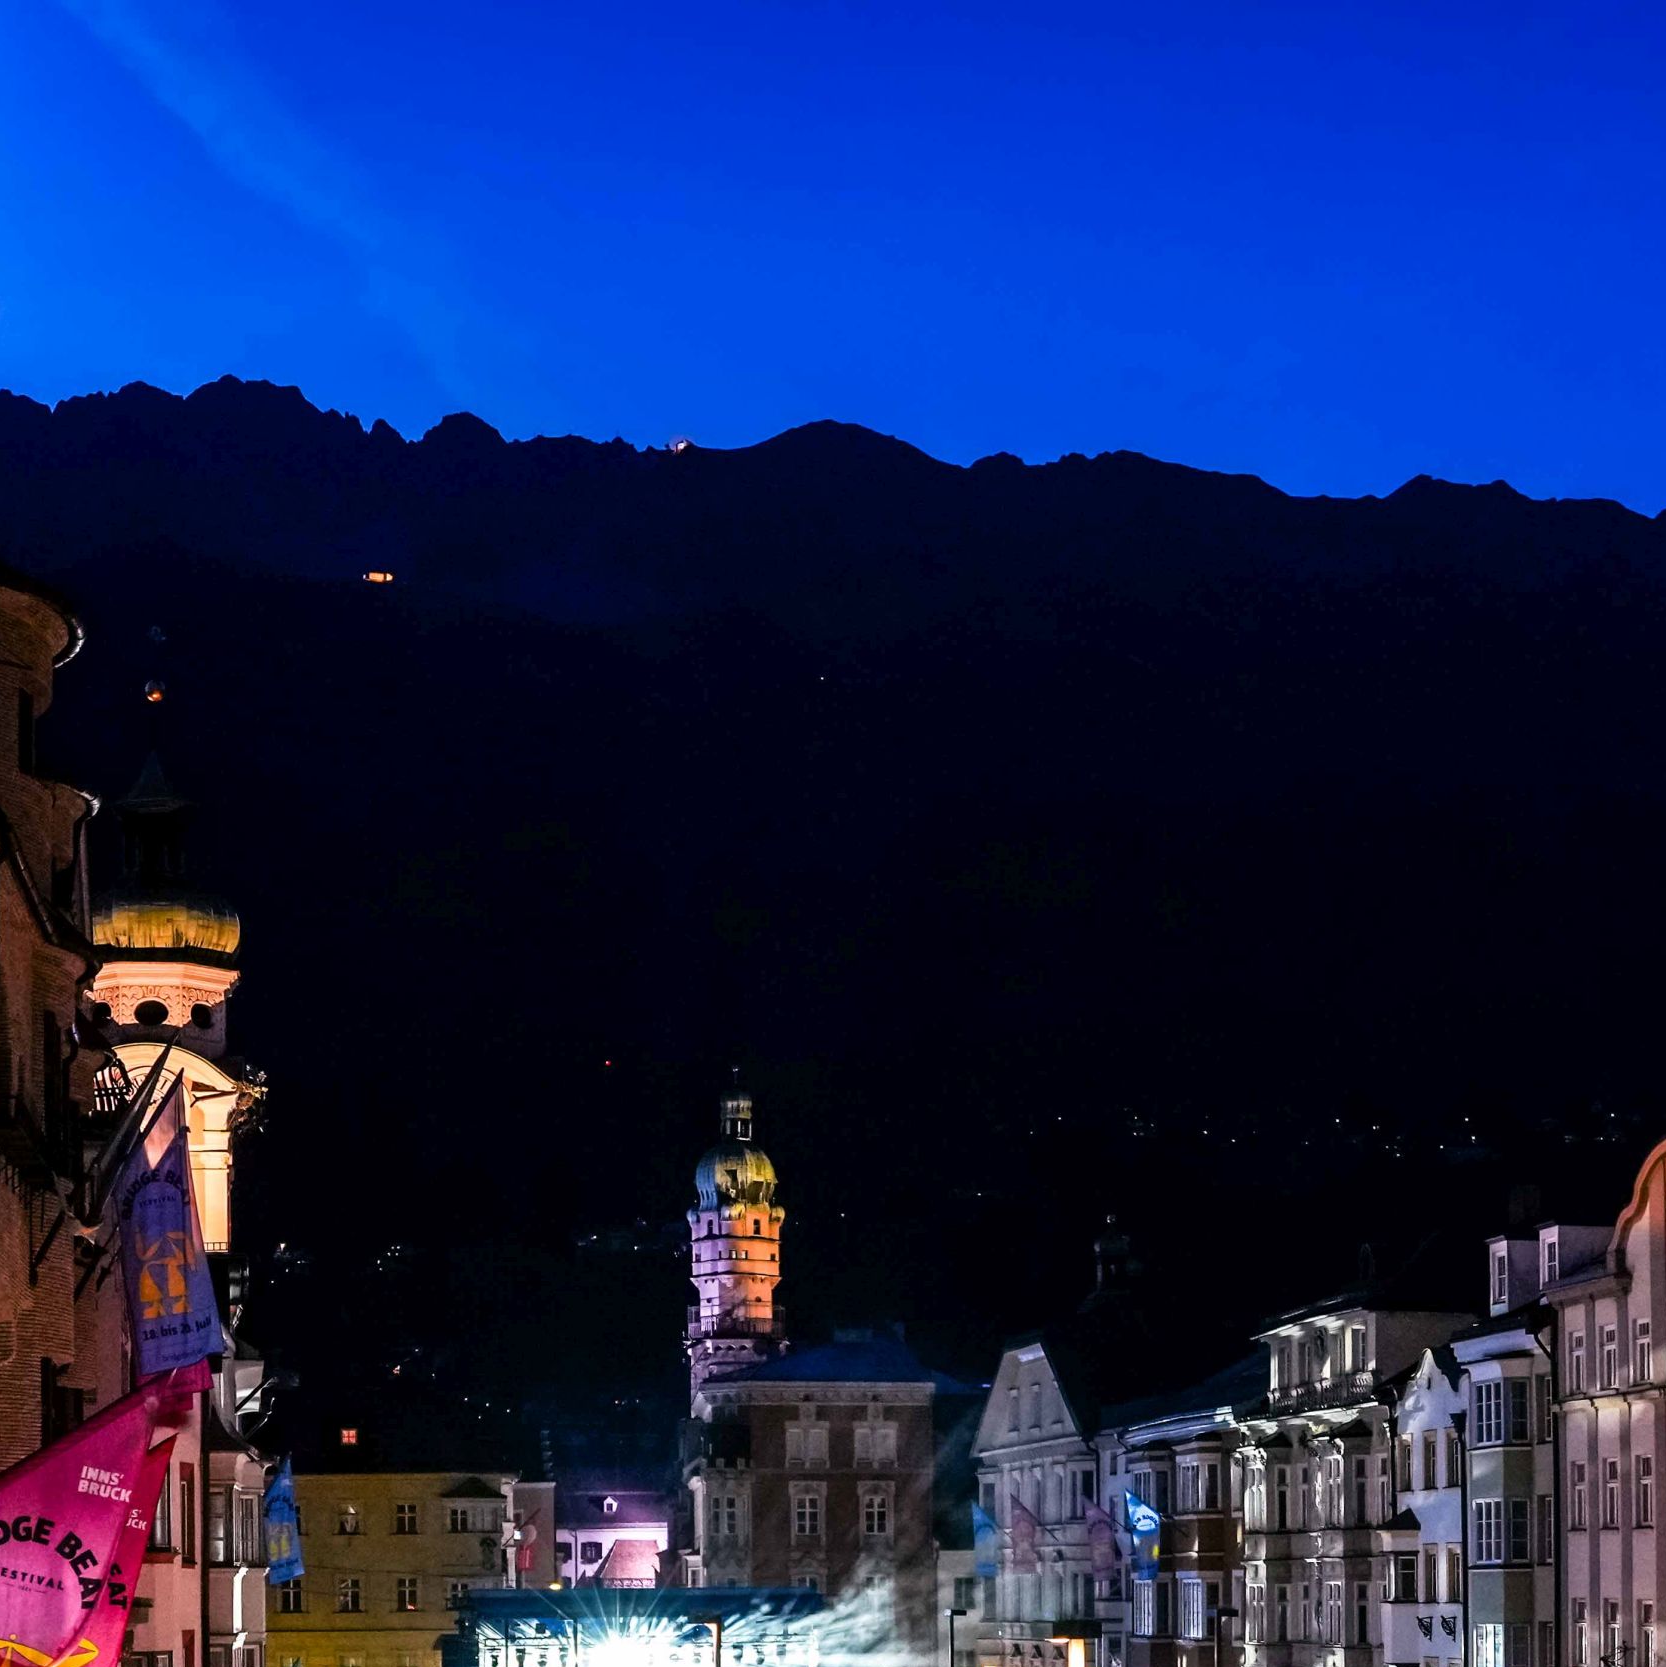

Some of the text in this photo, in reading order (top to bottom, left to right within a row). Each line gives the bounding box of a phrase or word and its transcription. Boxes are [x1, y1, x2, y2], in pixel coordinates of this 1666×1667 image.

[160, 1324, 178, 1337] bis
[81, 1465, 124, 1486] INNS'
[77, 1480, 132, 1503] BRUCK
